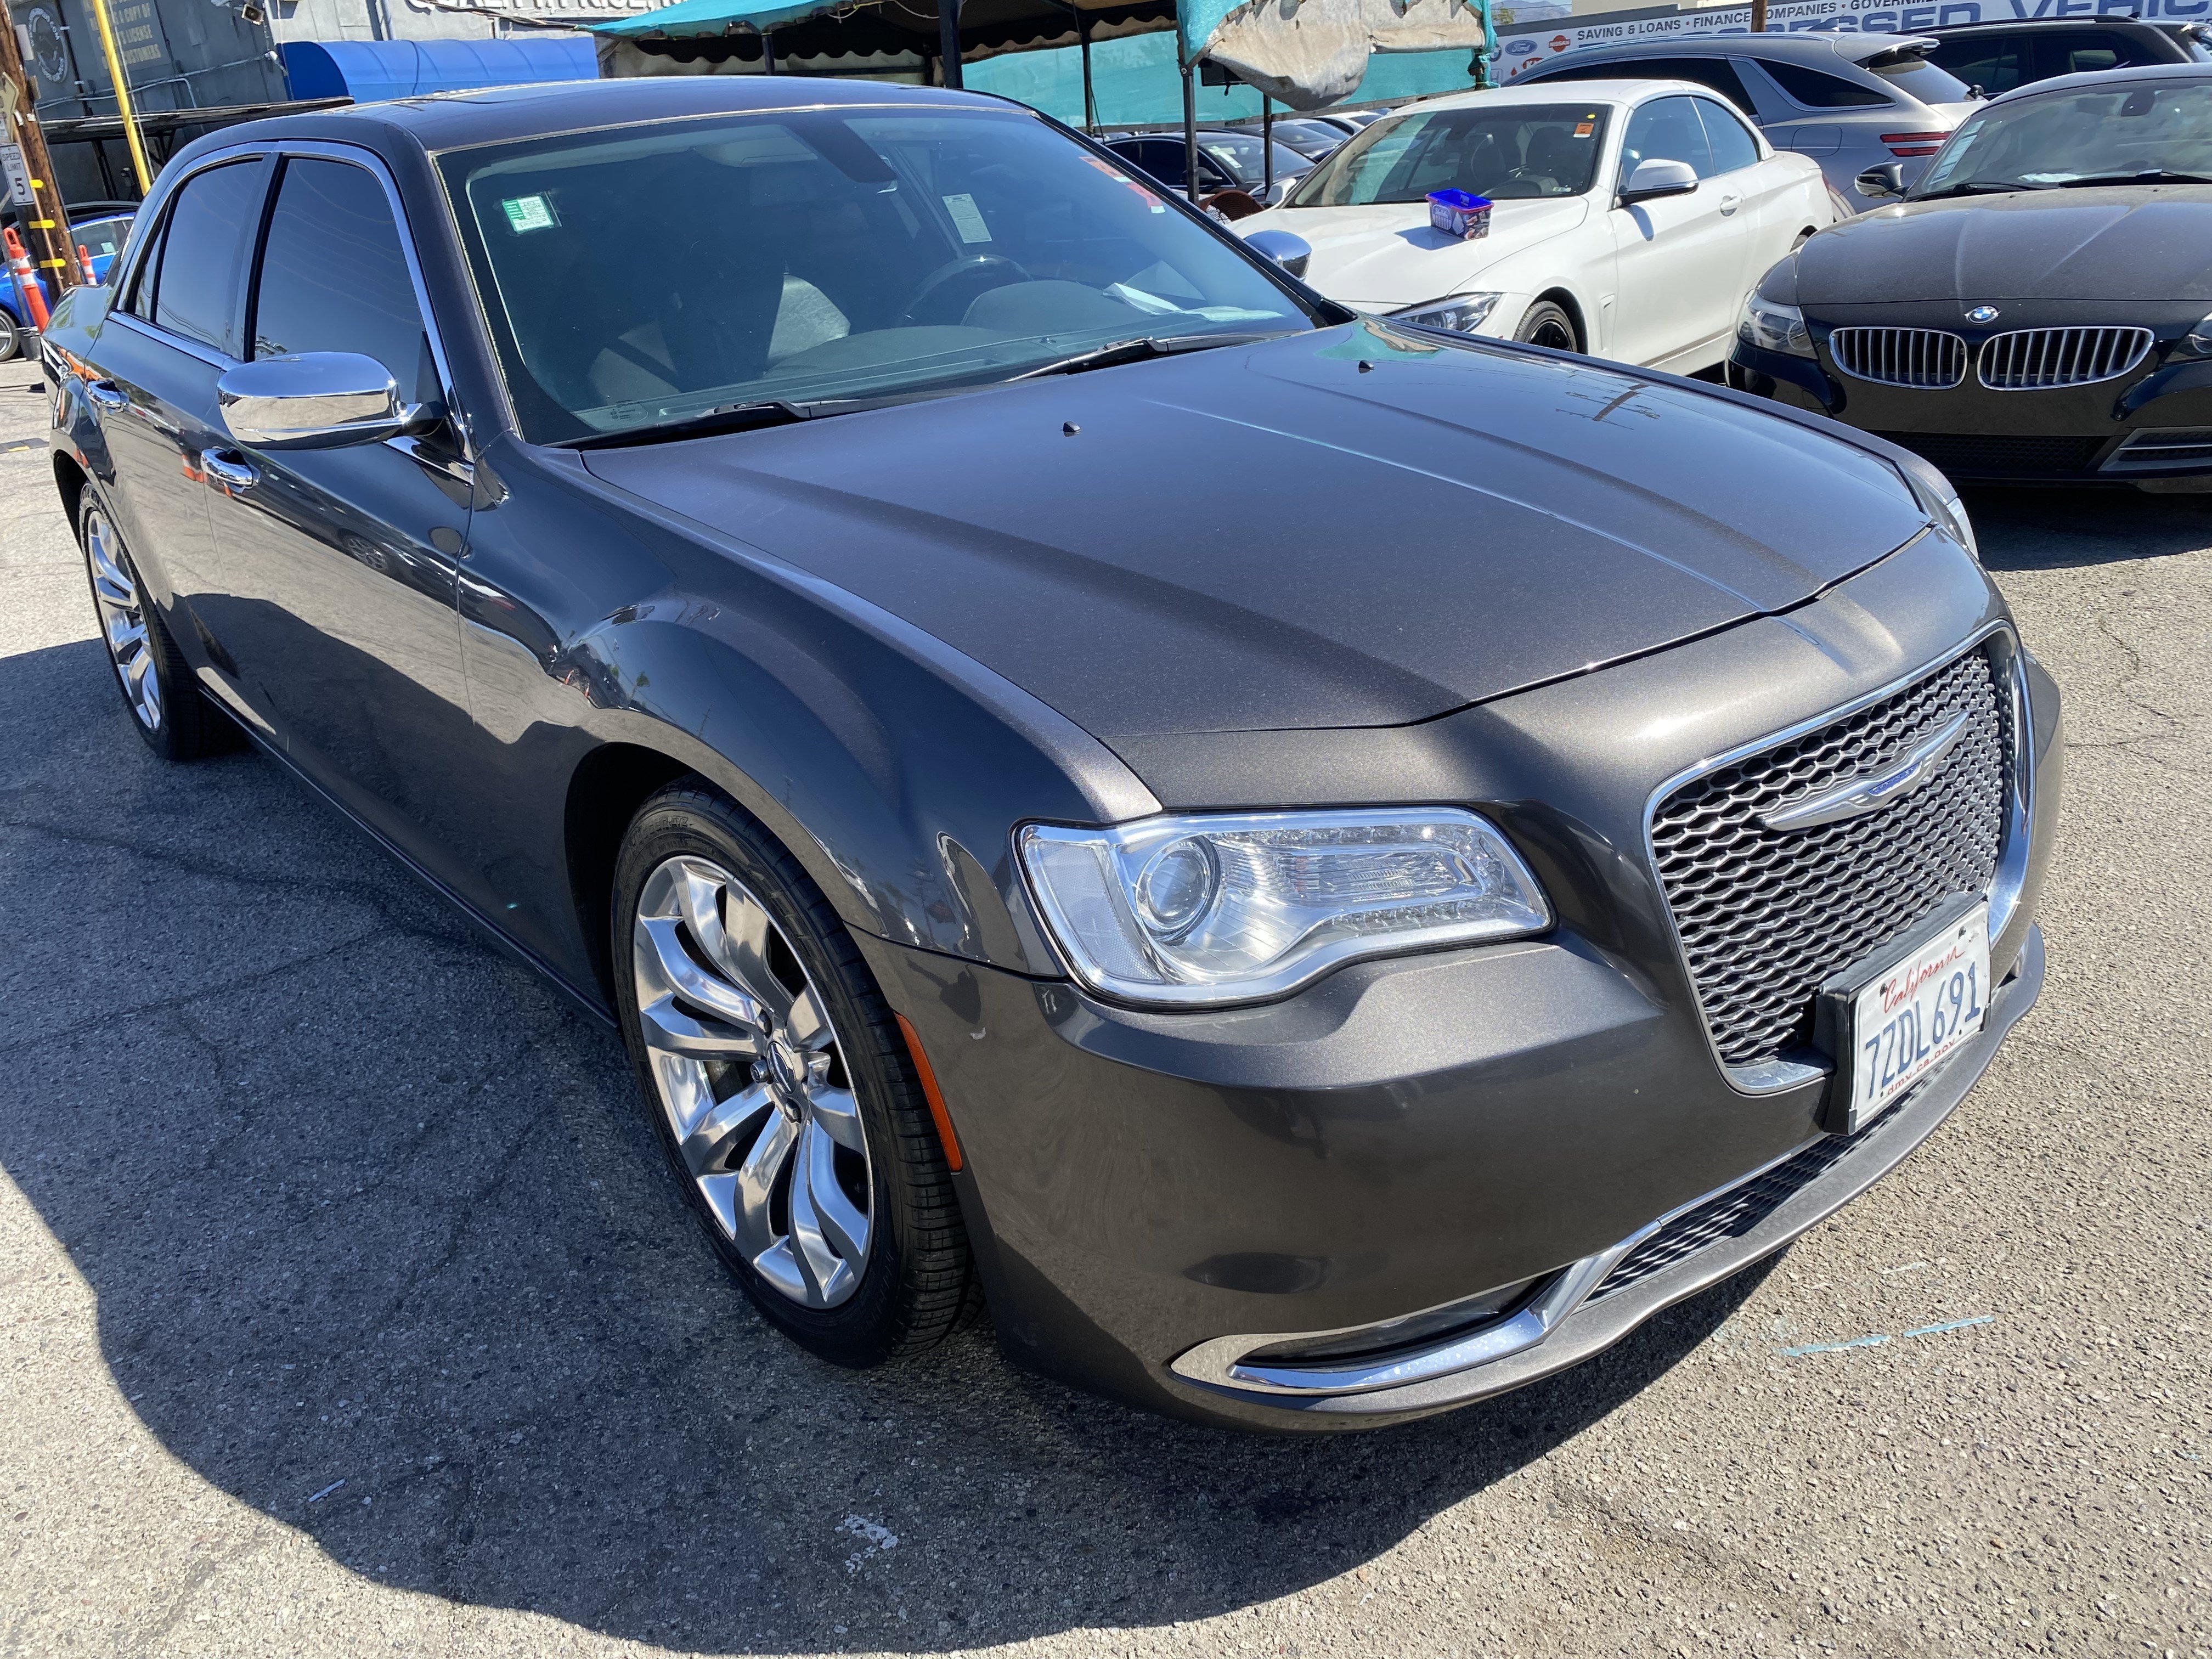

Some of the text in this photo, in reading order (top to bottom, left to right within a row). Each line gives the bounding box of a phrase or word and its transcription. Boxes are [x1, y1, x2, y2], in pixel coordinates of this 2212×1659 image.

[1577, 26, 1623, 41] SAVING
[1628, 25, 1635, 35] &
[1639, 20, 1681, 34] LOANS
[1694, 11, 1751, 28] FINANCE
[1766, 3, 1837, 20] OMPANIES
[1511, 43, 1531, 53] Ford
[2, 152, 21, 161] SPEED
[8, 163, 22, 172] LIMIT
[14, 178, 25, 195] 5
[1884, 945, 1965, 1014] California
[1866, 961, 1980, 1099] 7ZDL691
